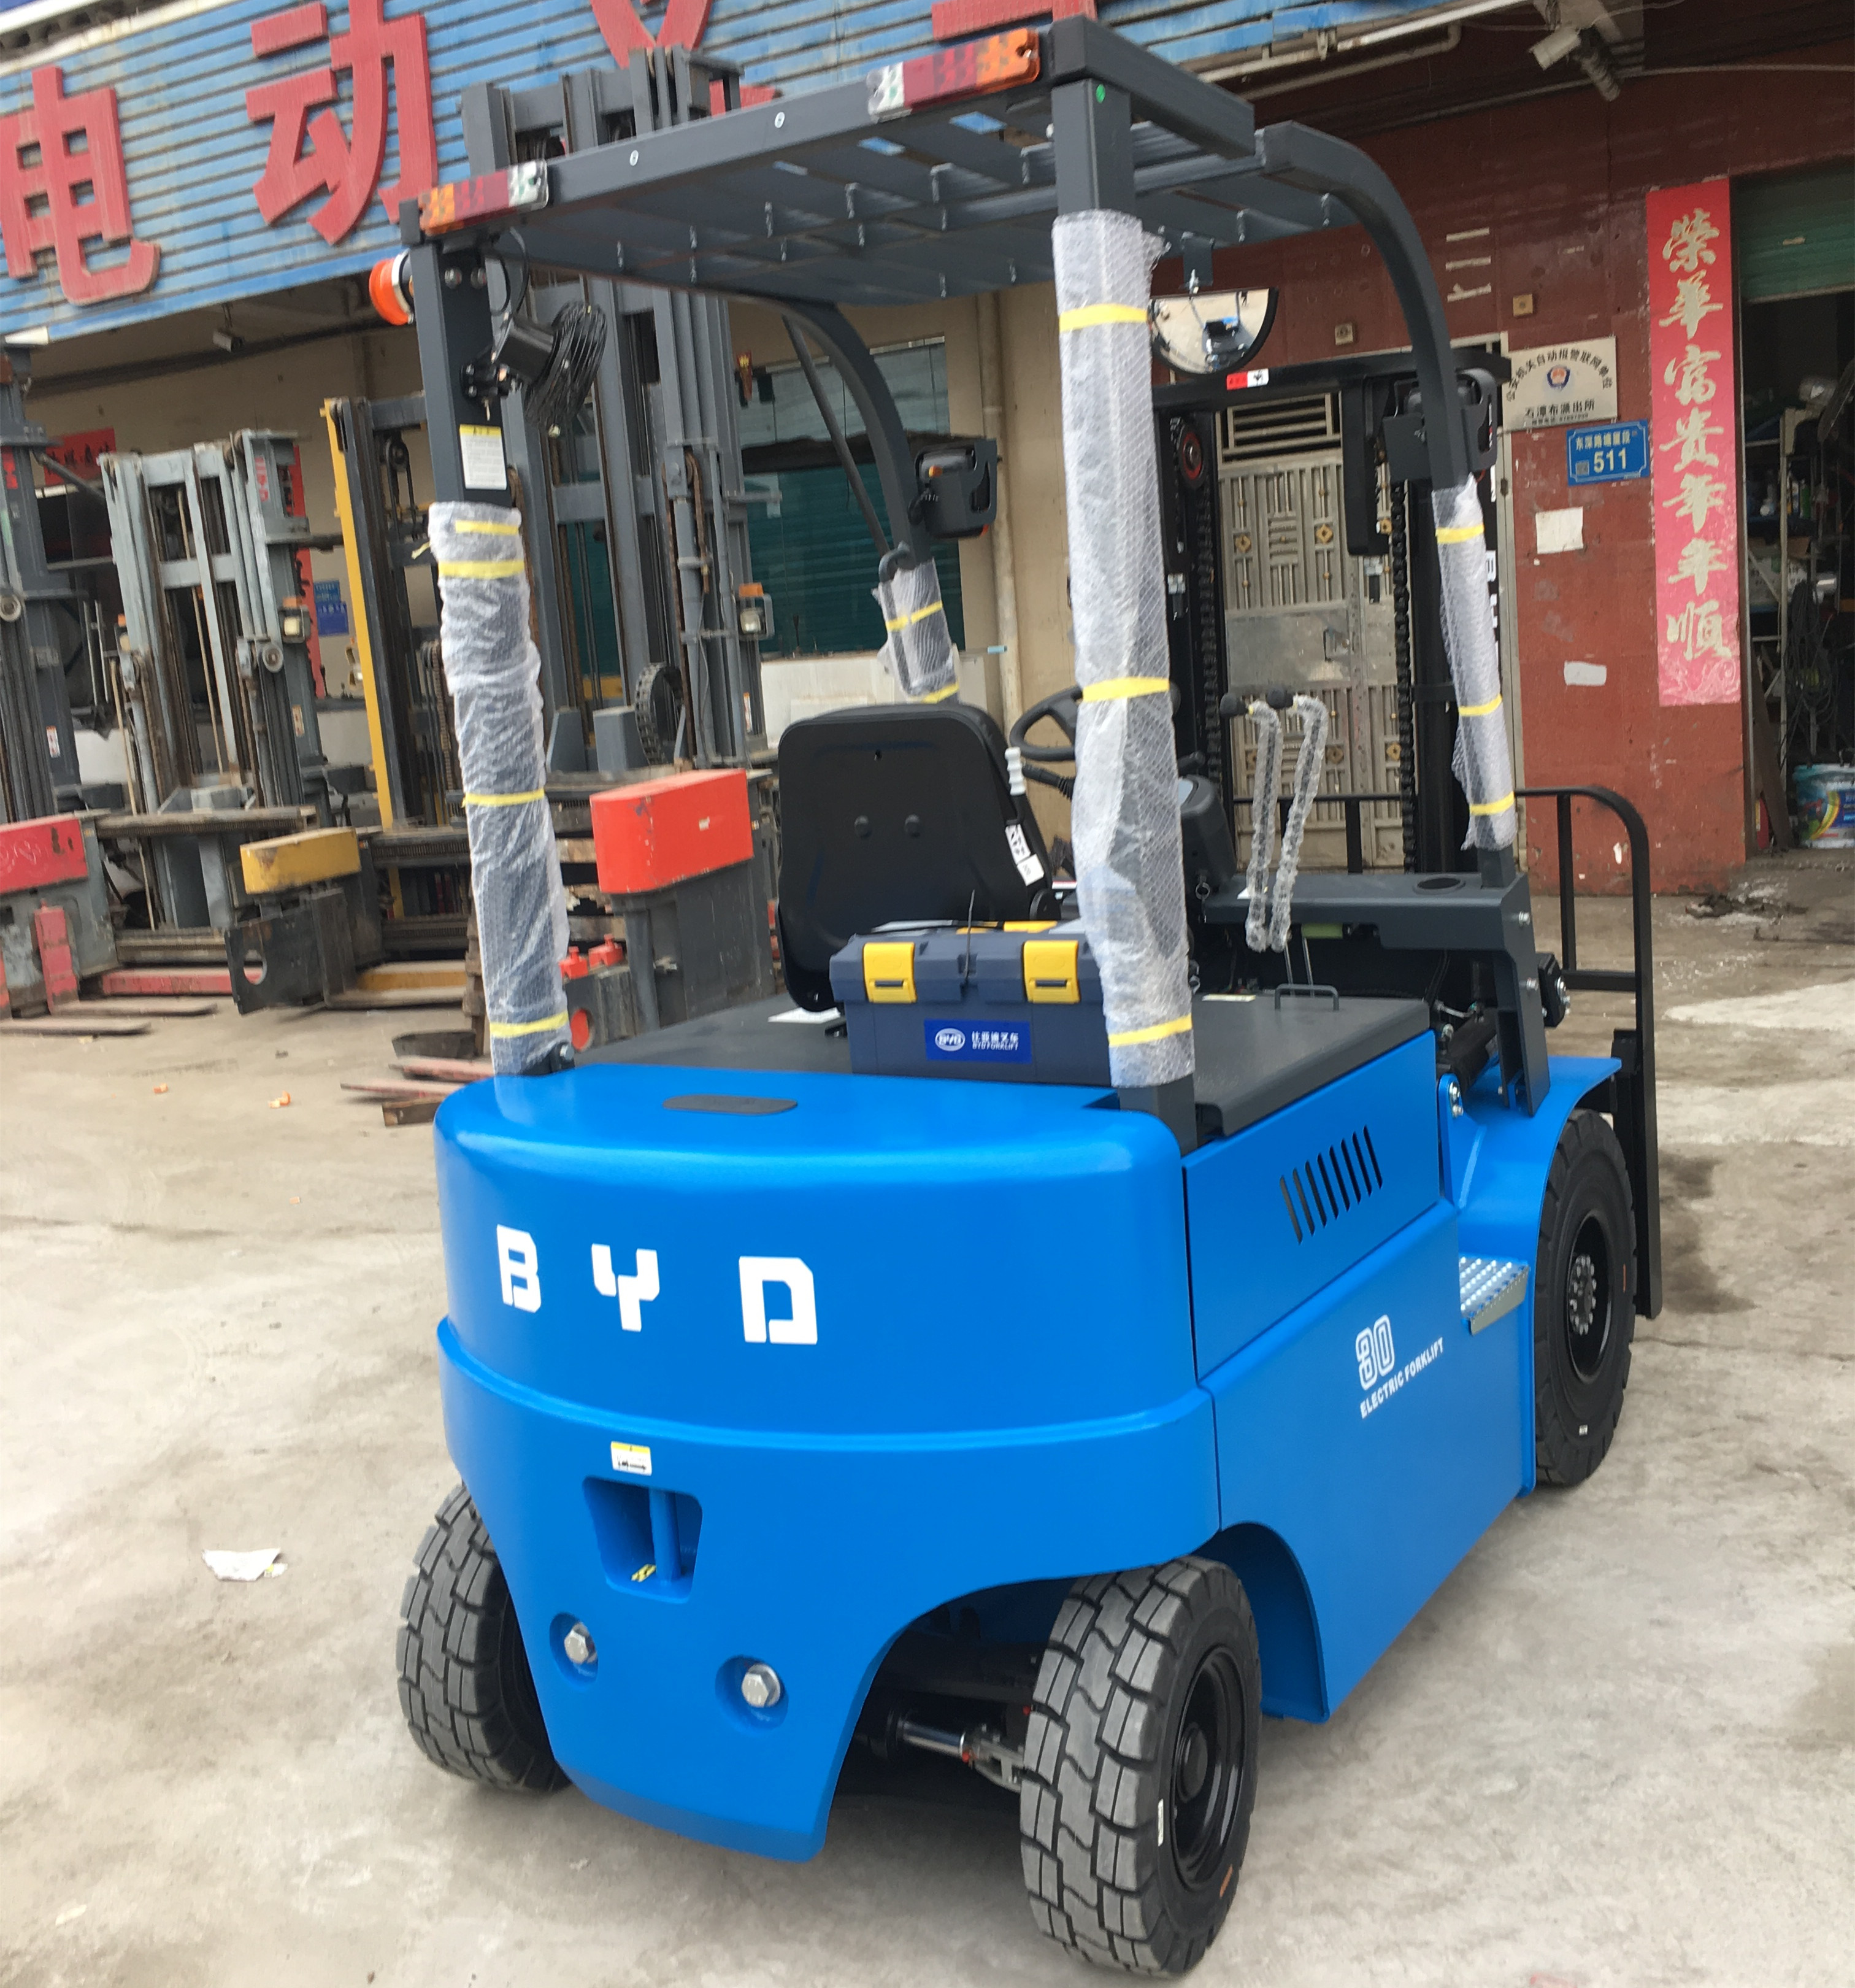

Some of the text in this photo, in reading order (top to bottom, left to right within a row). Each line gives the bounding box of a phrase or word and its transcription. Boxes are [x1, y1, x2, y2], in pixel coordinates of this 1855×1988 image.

[1594, 447, 1626, 473] 511
[497, 1223, 818, 1346] BYD
[1360, 1336, 1443, 1419] ELECTRIC FORKLIFT
